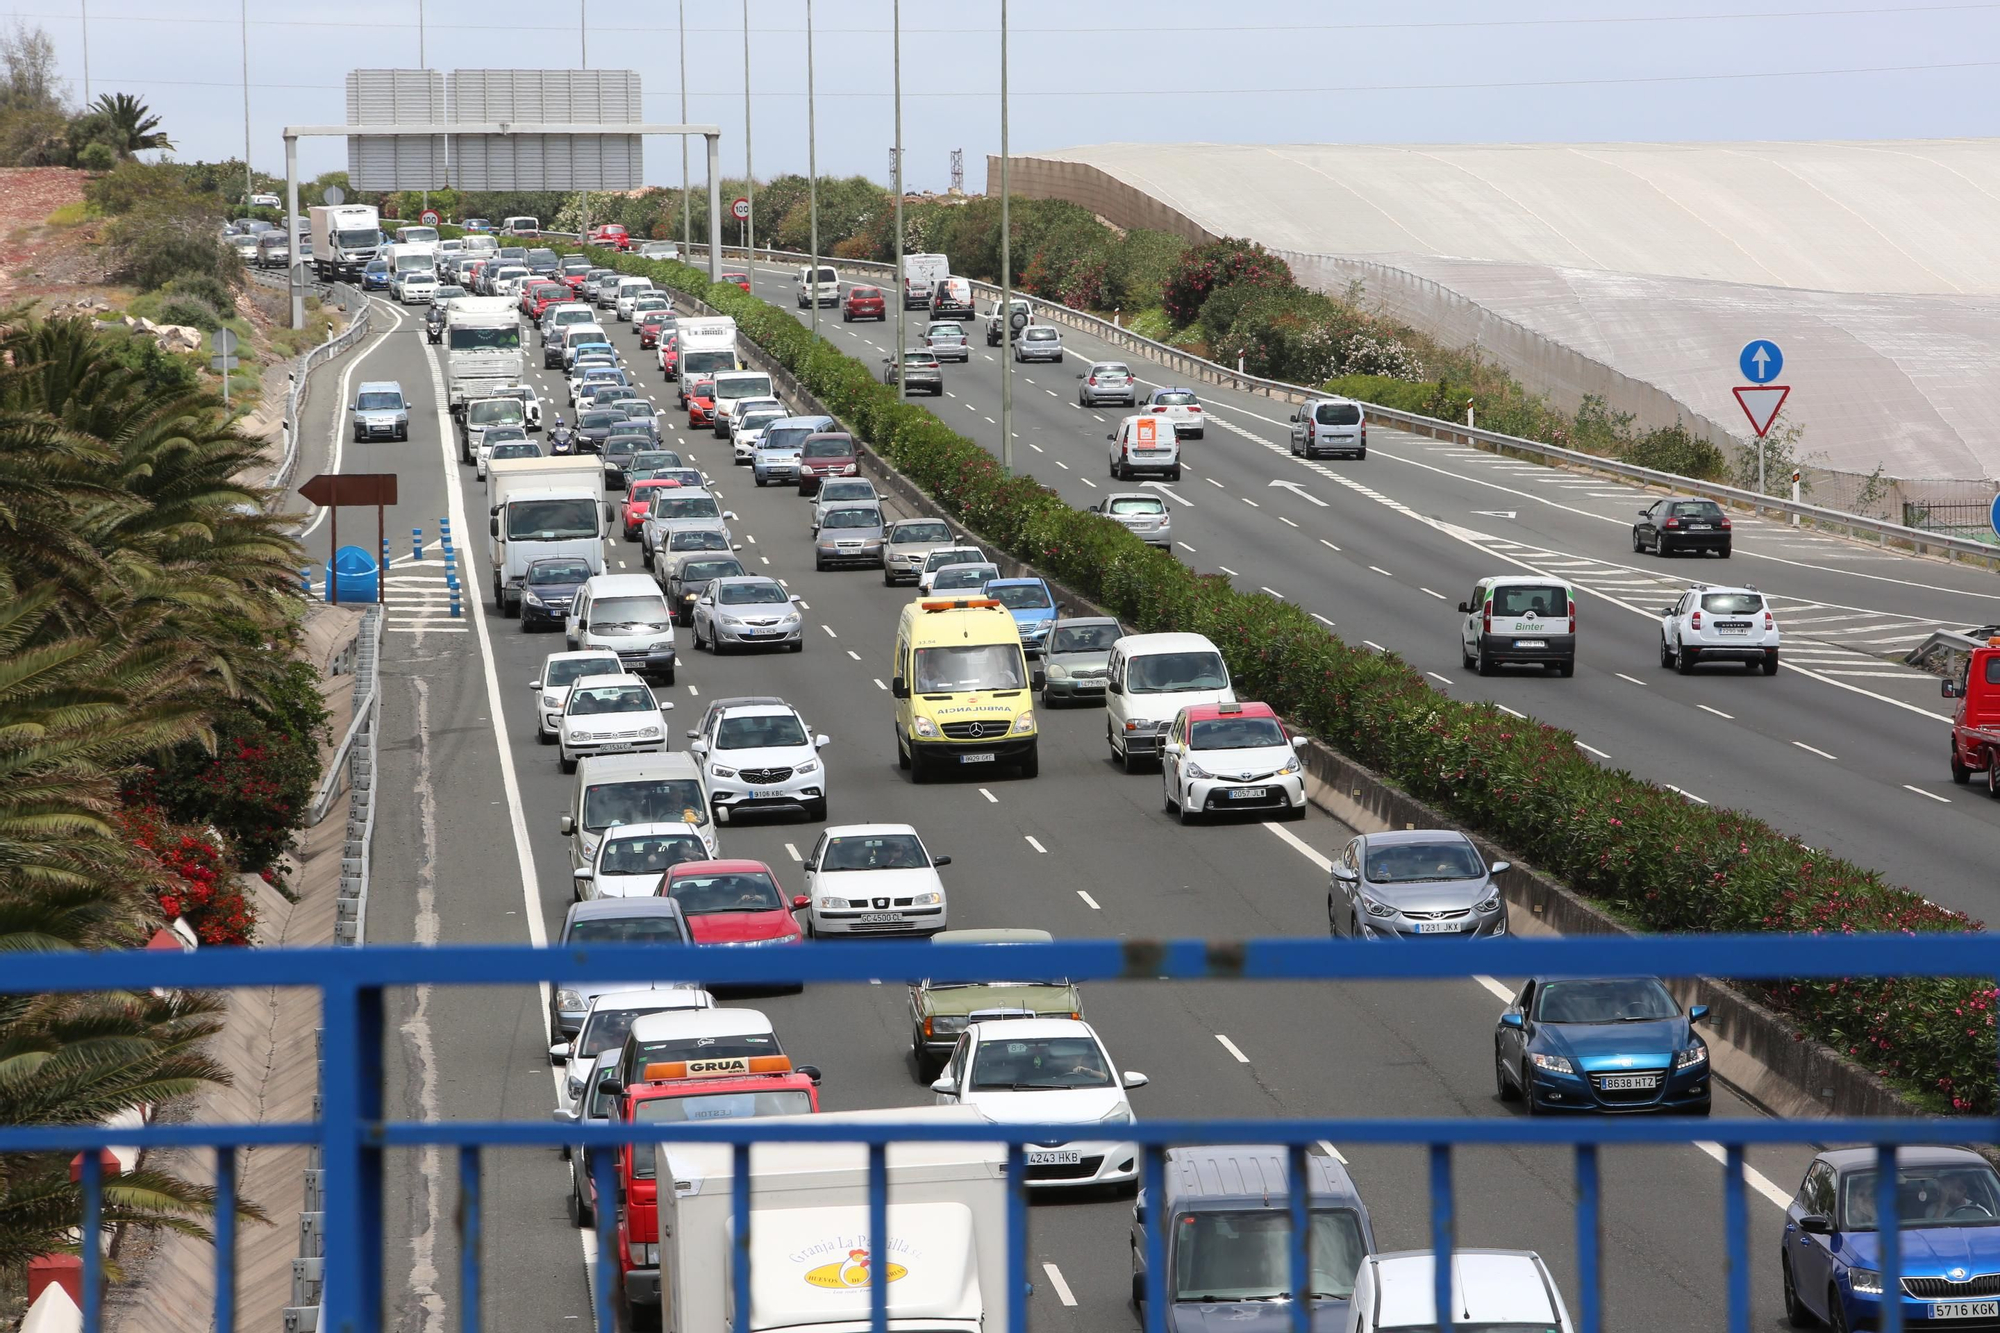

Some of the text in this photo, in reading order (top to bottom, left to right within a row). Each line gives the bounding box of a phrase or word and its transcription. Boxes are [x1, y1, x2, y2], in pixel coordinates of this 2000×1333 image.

[736, 205, 749, 213] 100
[423, 216, 437, 224] 100
[1515, 623, 1544, 631] Binter
[1233, 790, 1250, 798] 2057
[861, 914, 872, 922] GC
[892, 913, 902, 921] CL
[1421, 923, 1458, 932] 1231 JKX
[690, 1060, 745, 1072] GRUA
[1607, 1077, 1654, 1088] 8638 HTZ
[1030, 1152, 1078, 1164] 4243 HKB
[789, 1239, 835, 1264] Granja
[837, 1236, 854, 1250] La
[858, 1234, 910, 1253] Pailla
[808, 1275, 838, 1284] HUEVOS
[1936, 1303, 1996, 1317] 5716 KGK
